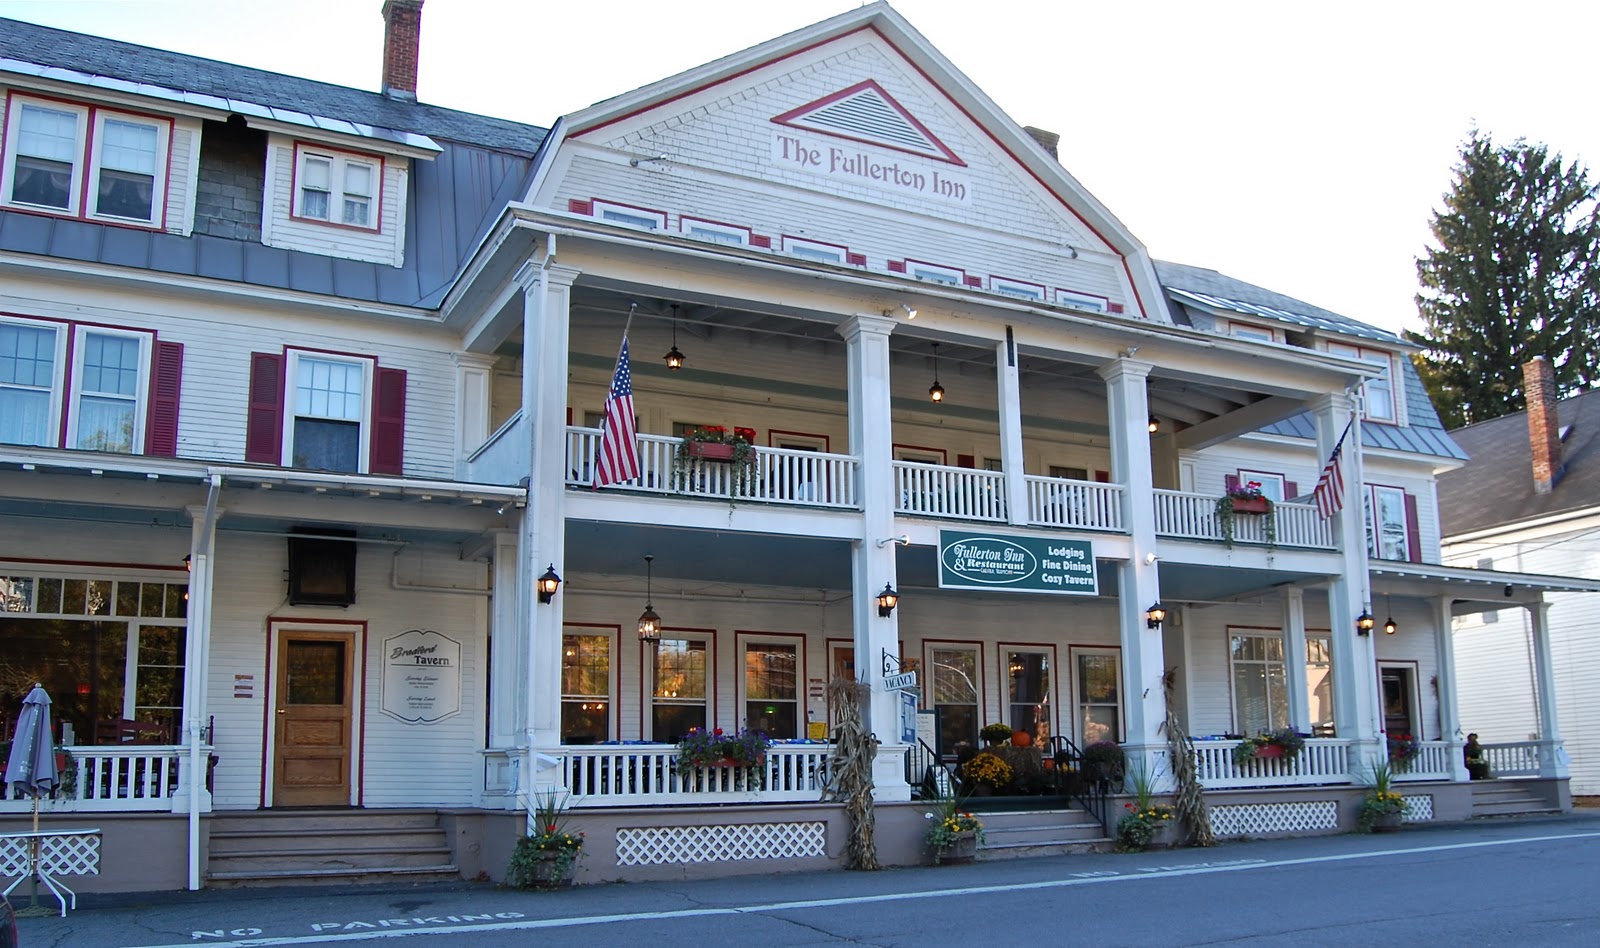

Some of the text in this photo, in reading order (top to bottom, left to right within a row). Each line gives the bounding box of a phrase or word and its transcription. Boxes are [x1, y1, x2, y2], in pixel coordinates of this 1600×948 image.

[777, 134, 966, 201] The Fullerton Inn
[954, 544, 1025, 562] Fullerton Inn
[1048, 546, 1084, 560] Lodging
[954, 558, 967, 571] &
[967, 558, 1024, 570] Restaurant
[1042, 559, 1092, 574] Fine Dining
[1041, 573, 1094, 585] Cozy Tavern
[390, 644, 438, 660] Bradford
[414, 655, 450, 665] Tavern
[884, 673, 912, 689] VACANCY
[191, 912, 525, 939] NO PARKING
